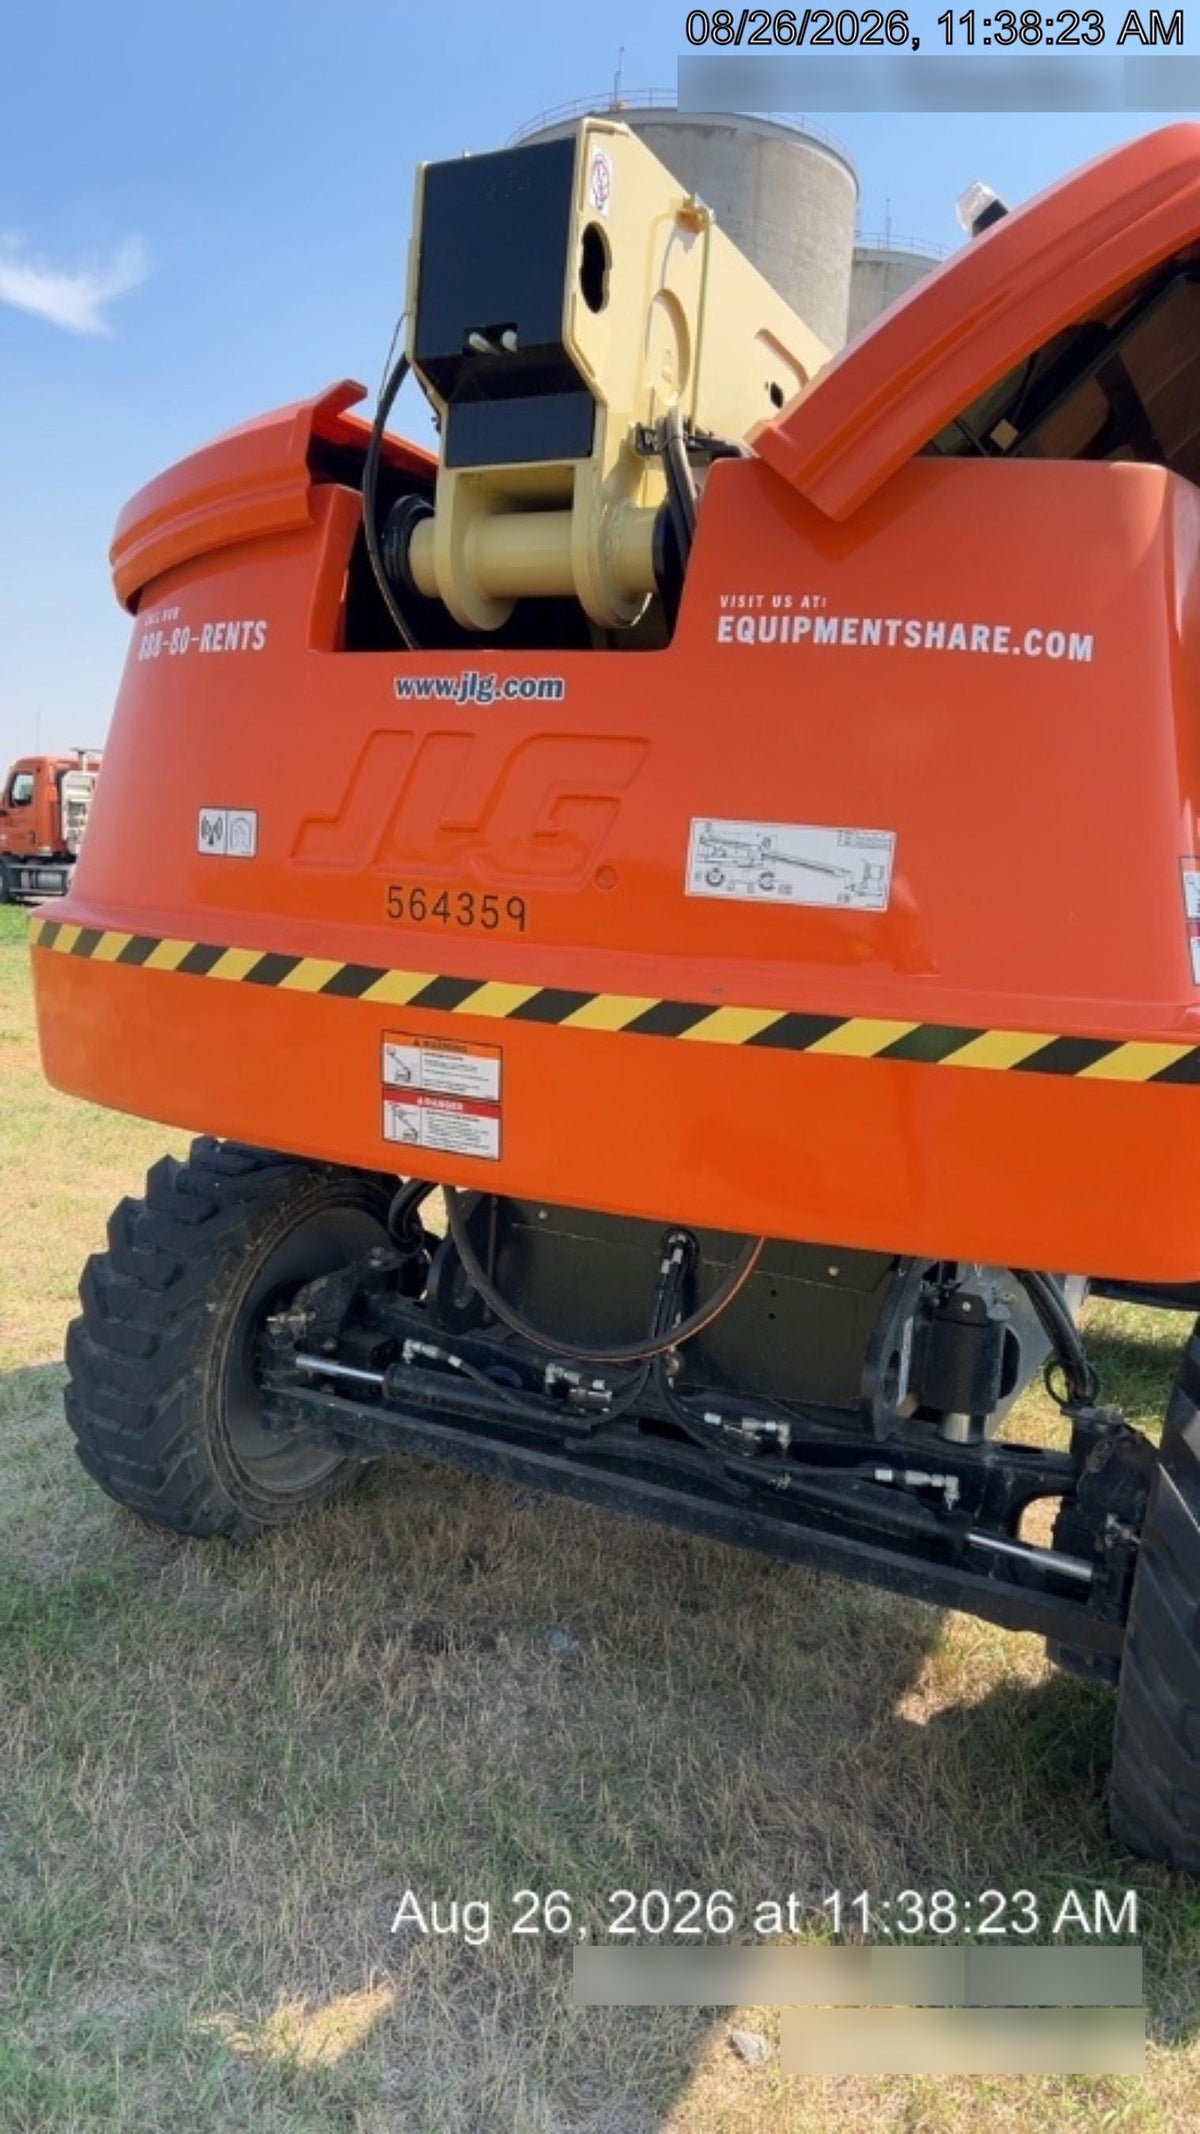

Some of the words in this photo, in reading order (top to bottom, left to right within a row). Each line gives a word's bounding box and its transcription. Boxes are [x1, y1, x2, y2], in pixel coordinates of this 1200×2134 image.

[720, 594, 764, 608] VISIT
[772, 594, 793, 608] US
[801, 594, 827, 609] AT:
[717, 615, 1095, 662] EQUIPMENTSHARE.COM
[394, 672, 565, 705] www.jlg.com
[386, 885, 527, 932] 564359
